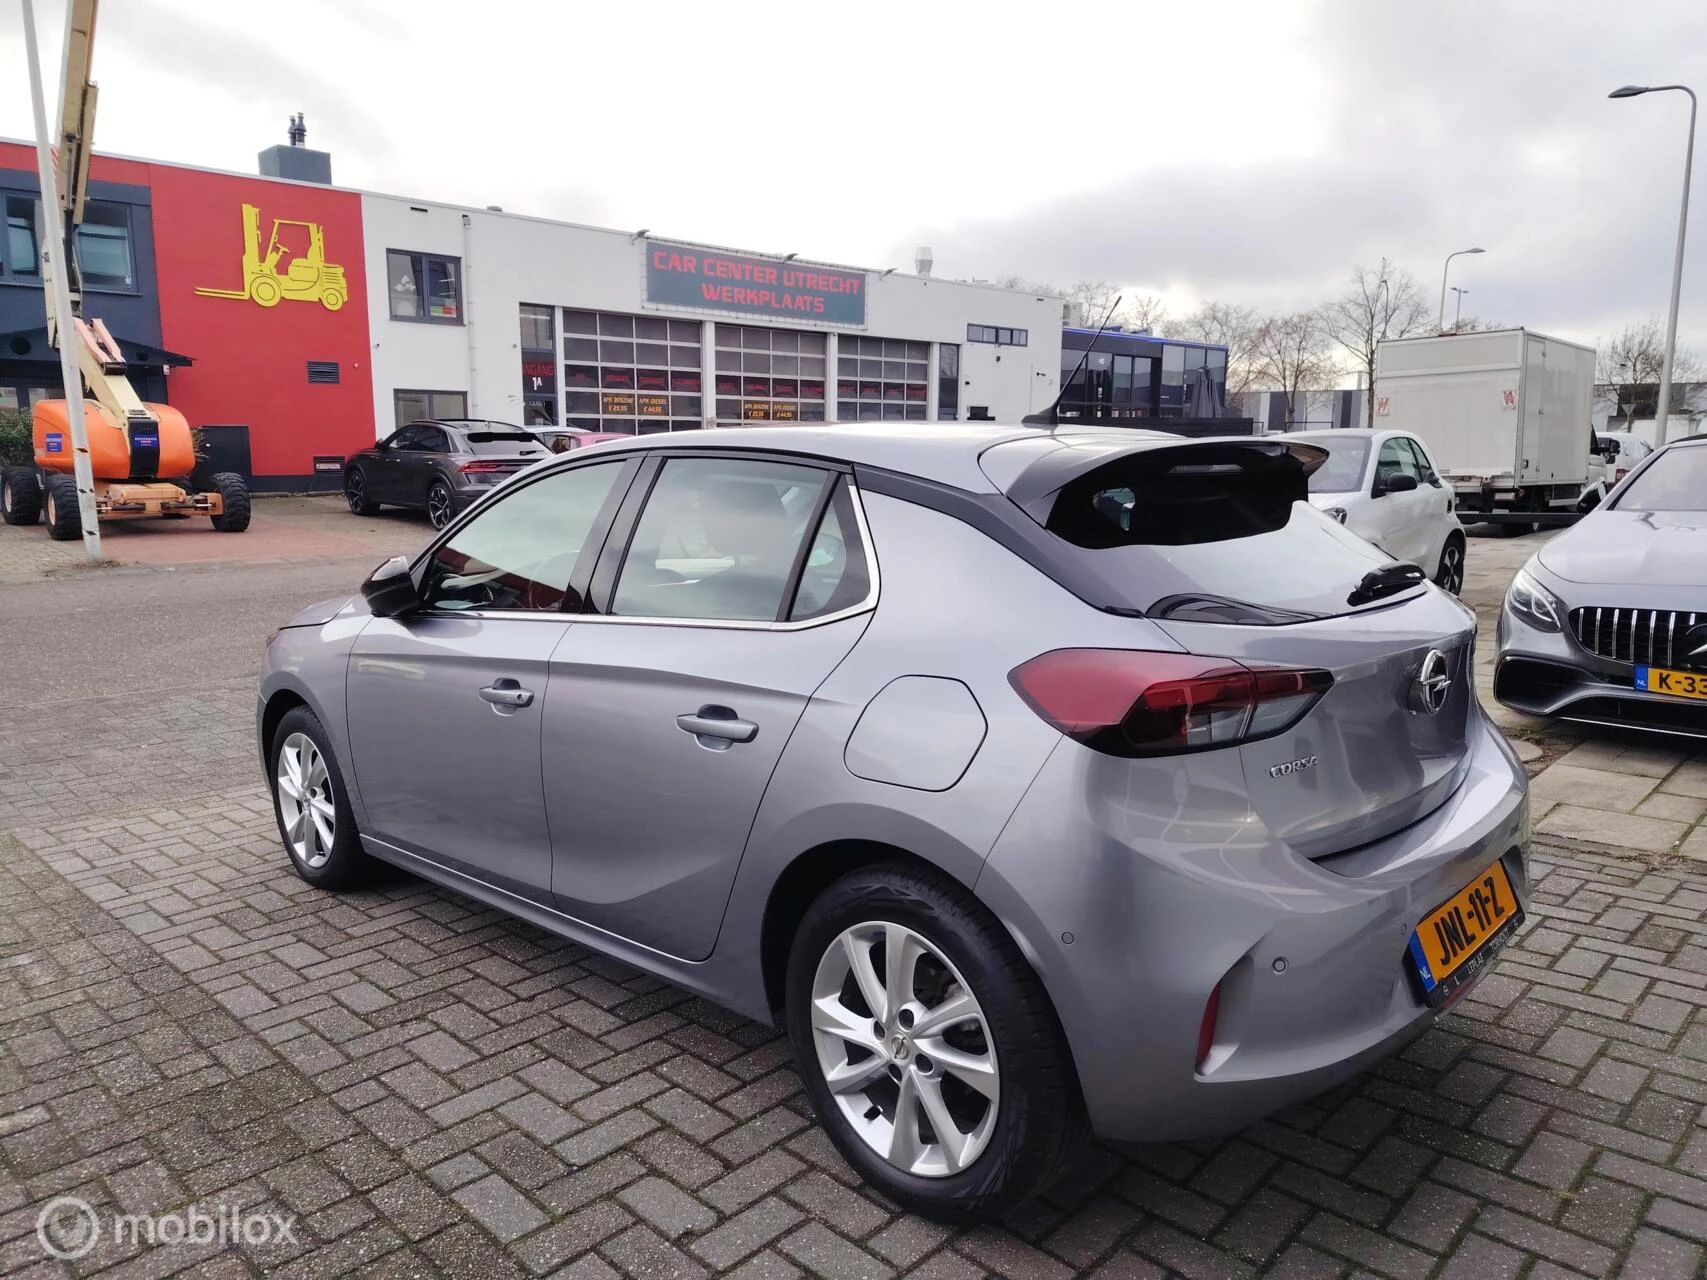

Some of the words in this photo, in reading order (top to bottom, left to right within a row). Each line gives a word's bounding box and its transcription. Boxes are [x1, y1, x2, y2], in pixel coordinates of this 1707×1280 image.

[653, 251, 697, 273] CAR
[702, 258, 777, 285] CENTER
[783, 271, 860, 295] UTRECHT
[701, 282, 825, 313] WERKPLAATS
[532, 377, 543, 391] 1A
[1636, 679, 1647, 688] NL
[1270, 756, 1318, 778] CORSA
[1433, 876, 1505, 967] JNL-11-Z
[1419, 966, 1431, 980] NL
